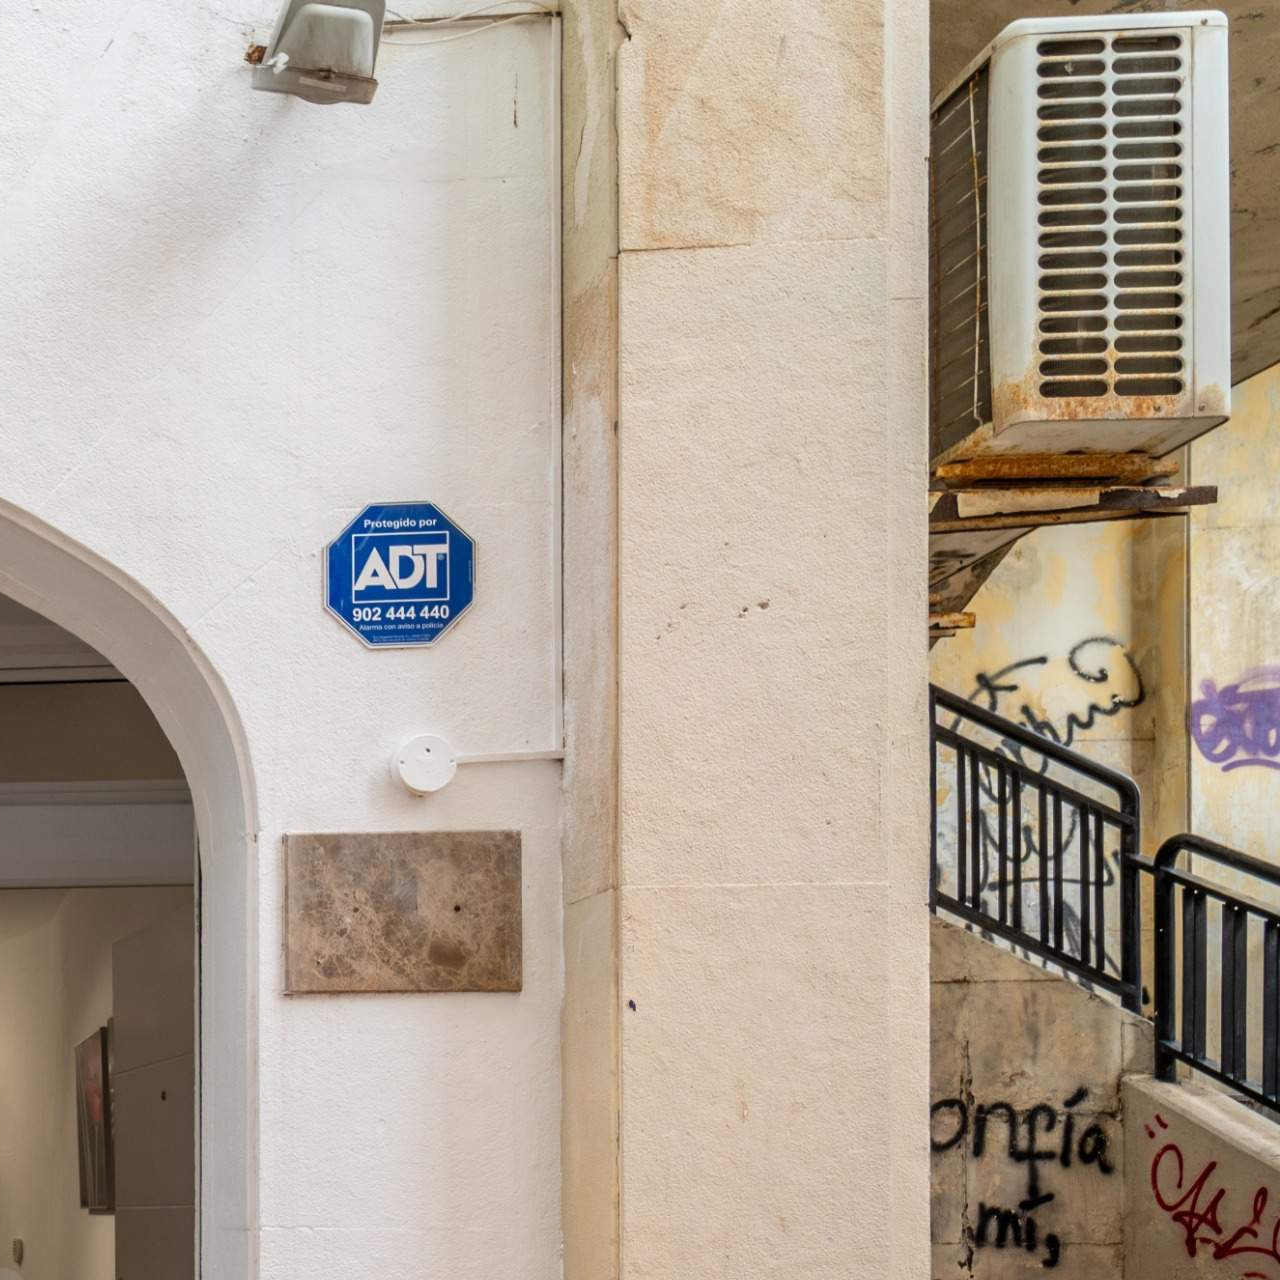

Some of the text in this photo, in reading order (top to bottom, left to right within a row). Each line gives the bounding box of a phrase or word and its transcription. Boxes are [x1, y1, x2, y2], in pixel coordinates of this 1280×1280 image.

[363, 518, 437, 529] Protegido por
[354, 543, 448, 591] ADT
[352, 605, 450, 621] 902 444 440
